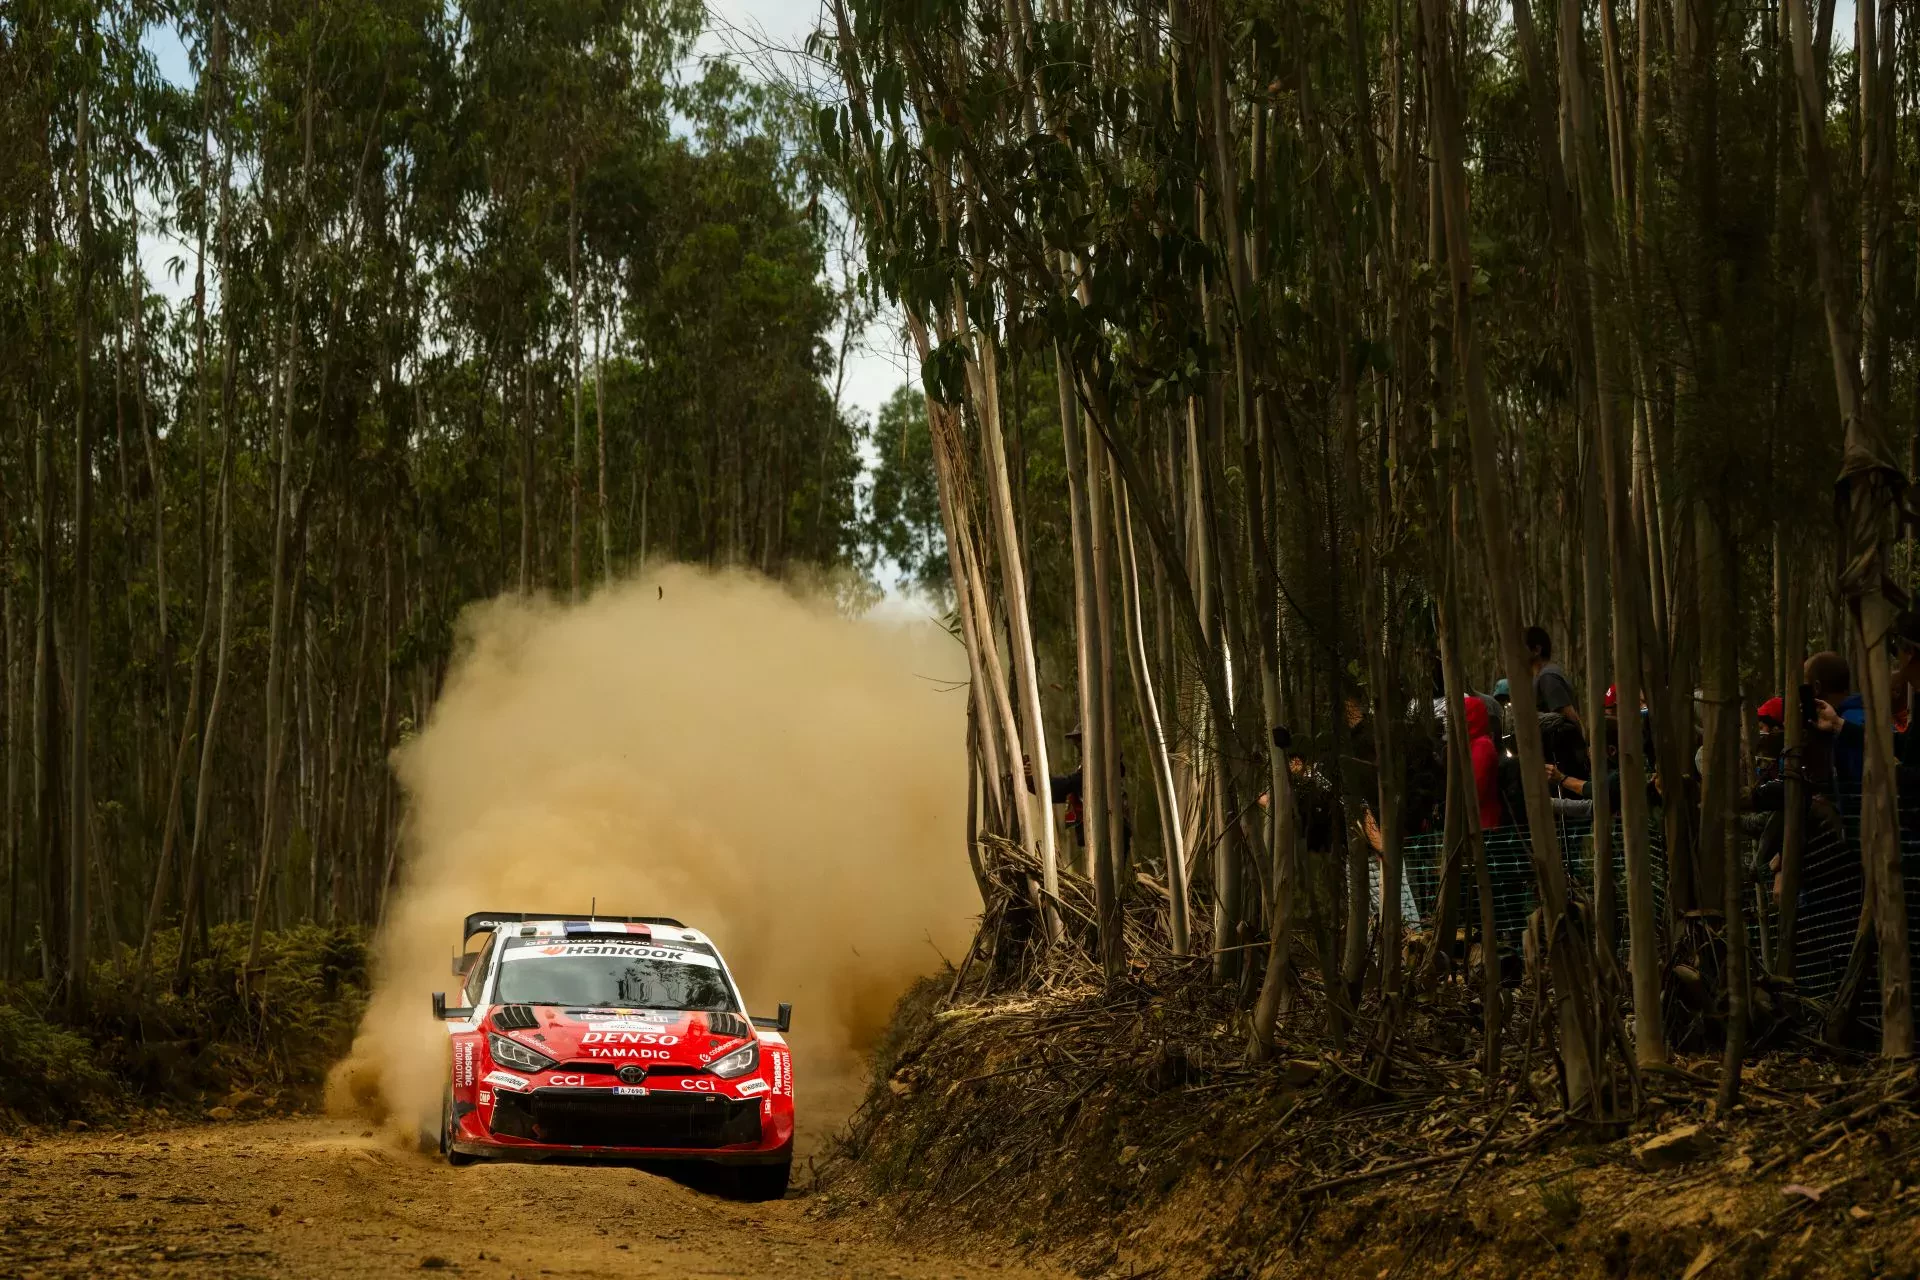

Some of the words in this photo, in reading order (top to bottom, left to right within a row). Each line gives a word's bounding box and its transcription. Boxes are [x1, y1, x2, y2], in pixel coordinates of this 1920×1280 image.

[582, 1033, 678, 1046] DENSO
[589, 1049, 670, 1059] TAMADIC
[455, 1042, 463, 1088] AUTOMOTIVE
[465, 1042, 474, 1086] Panasonic
[772, 1051, 782, 1094] Panasonic
[783, 1051, 792, 1097] AUTOMOTIVE
